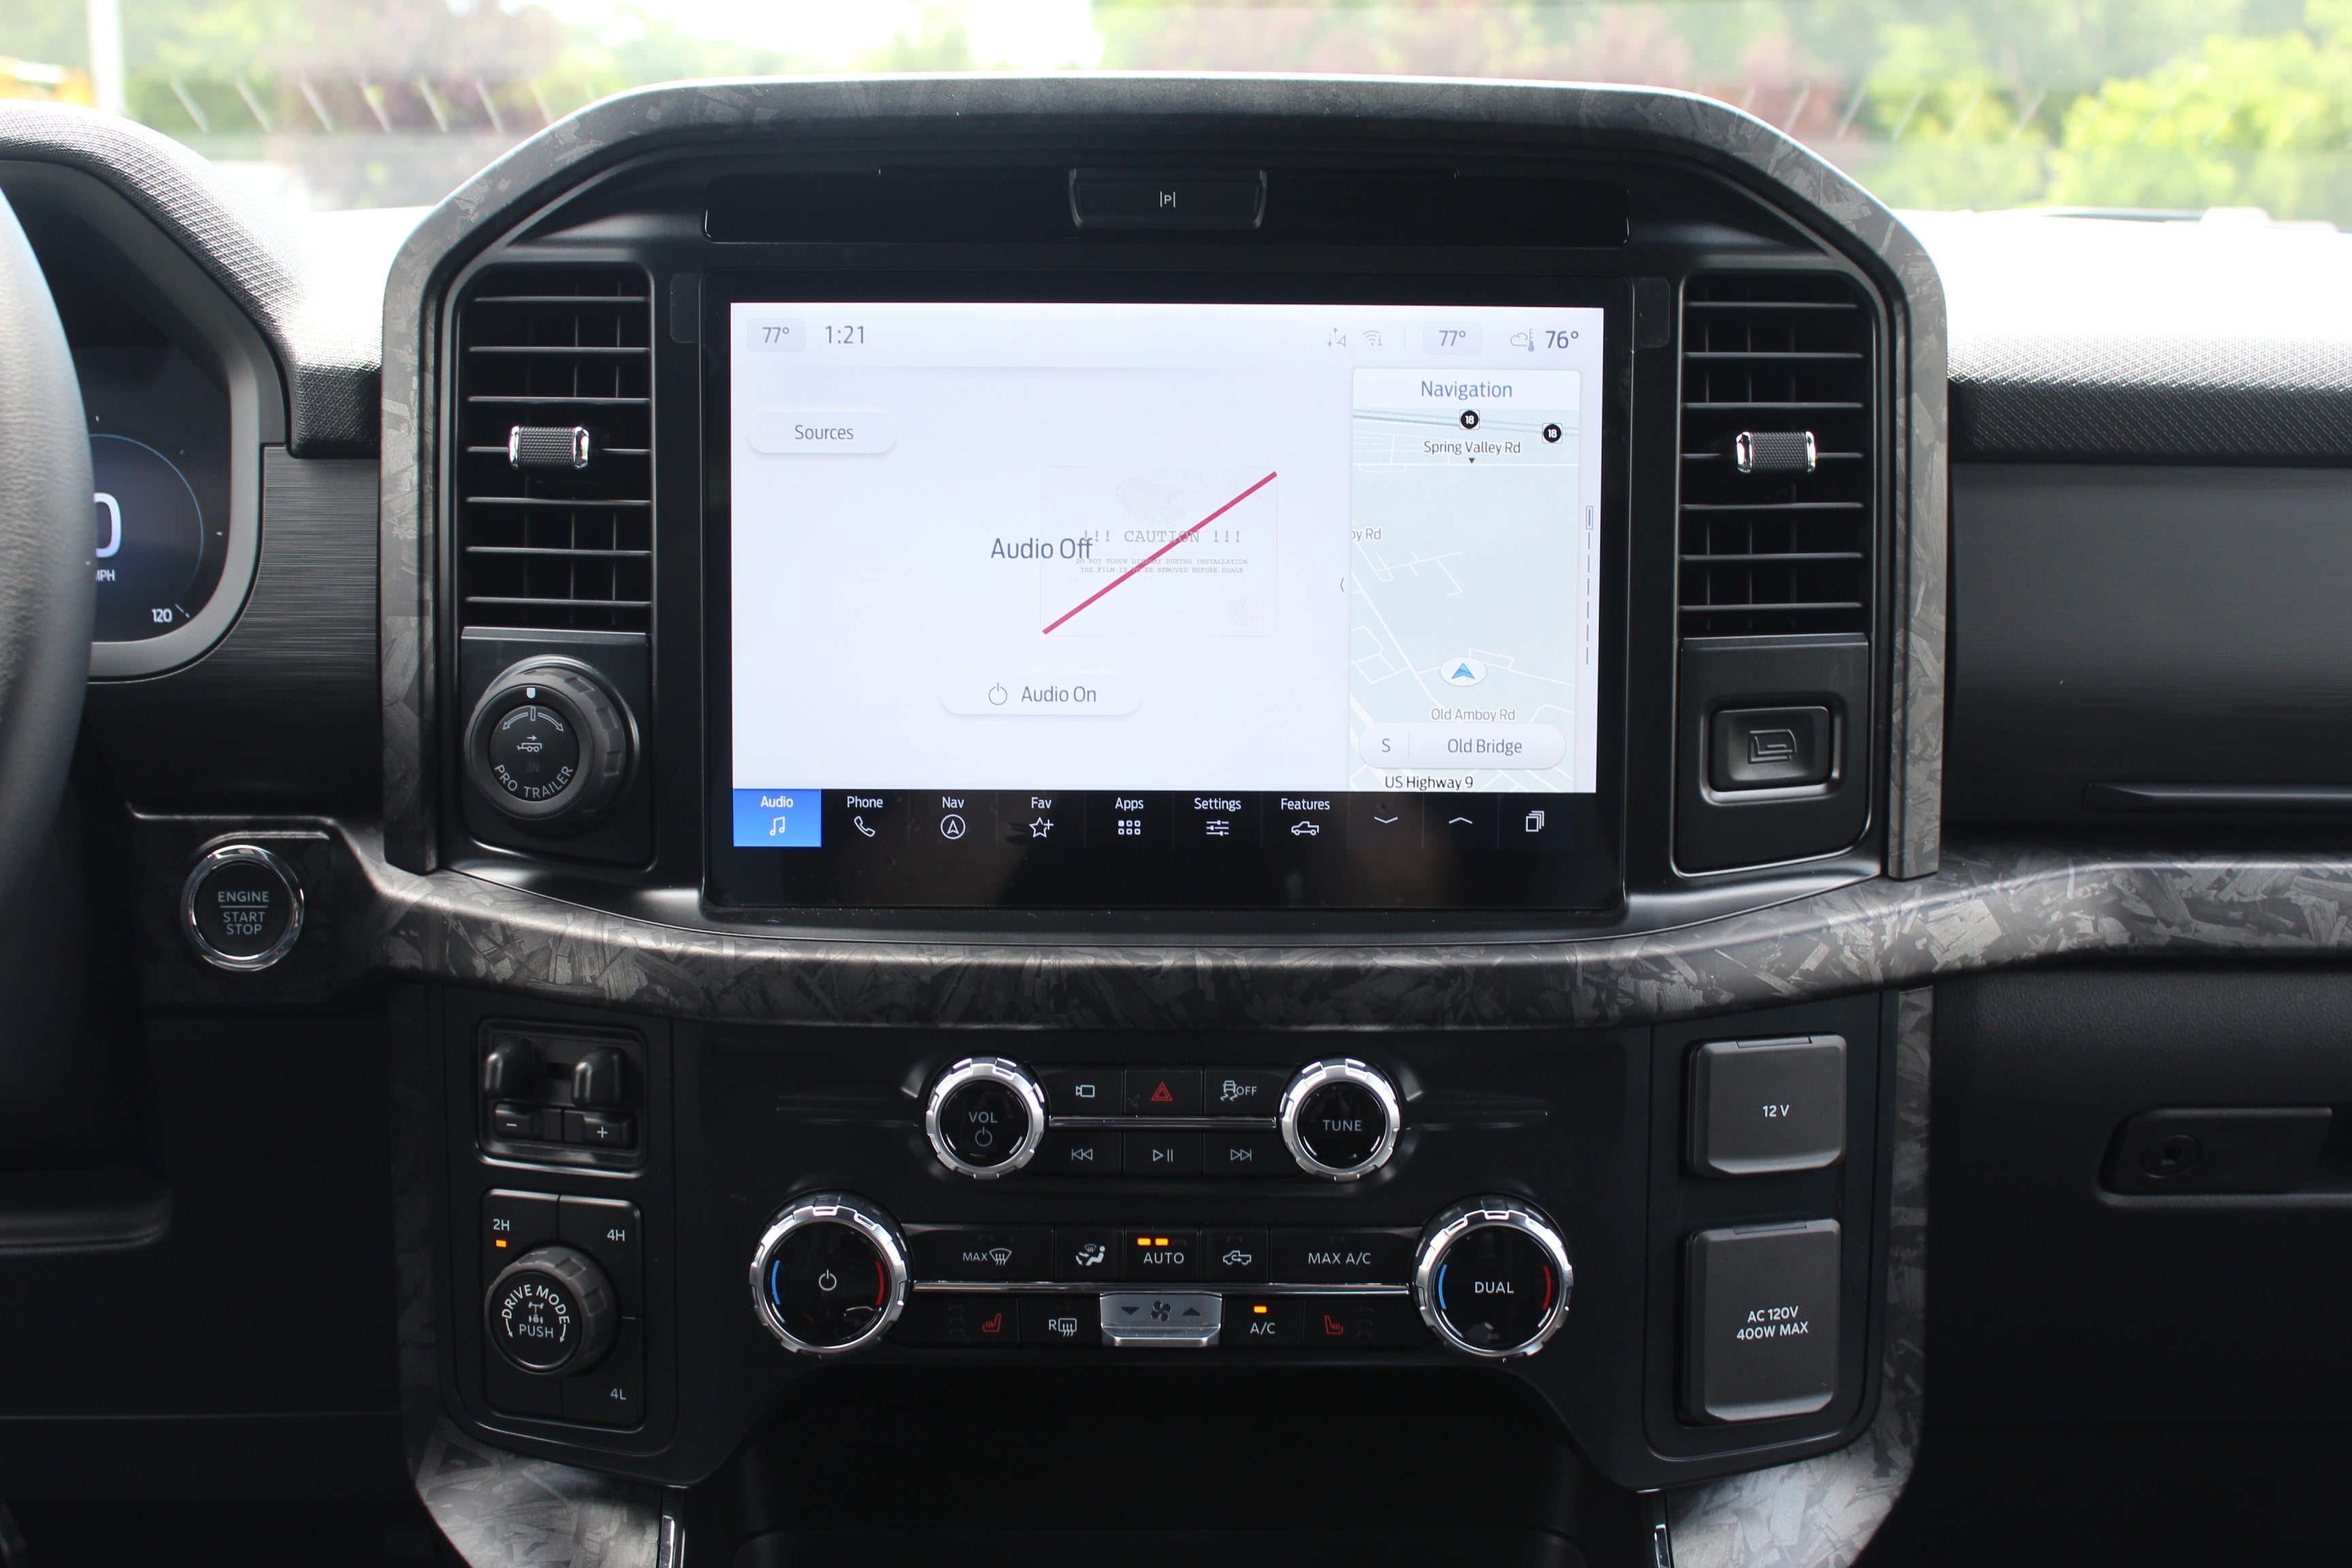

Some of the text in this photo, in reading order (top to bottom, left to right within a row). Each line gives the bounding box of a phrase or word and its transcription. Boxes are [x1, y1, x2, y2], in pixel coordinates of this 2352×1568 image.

[762, 327, 790, 344] 77°
[824, 325, 866, 344] 1:21
[1438, 329, 1467, 347] 77°
[1544, 330, 1580, 349] 76°
[1421, 380, 1513, 400] Navigation
[1465, 414, 1475, 425] 18
[794, 424, 855, 441] Sources
[1547, 428, 1558, 438] 18
[1423, 441, 1521, 455] Spring Valley Rd
[1124, 530, 1200, 542] CAUTION
[1365, 527, 1382, 540] Rd
[990, 537, 1093, 559] Audio Off
[151, 608, 173, 623] 120
[1021, 685, 1097, 703] Audio On
[1431, 708, 1516, 723] Old Amboy Rd
[1381, 738, 1391, 753] S
[1447, 738, 1523, 756] Old Bridge
[494, 764, 574, 799] PRO TRAILER
[1384, 776, 1474, 791] US Highway 9
[760, 796, 794, 808] Audio
[846, 796, 883, 808] Phone
[942, 796, 965, 808] Nav
[1030, 797, 1052, 809] Fav
[1115, 797, 1145, 811] Apps
[1194, 797, 1242, 812] Settings
[1280, 798, 1330, 811] Features
[218, 891, 270, 902] ENGINE
[223, 911, 265, 922] START
[227, 924, 262, 935] STOP
[1236, 1085, 1258, 1096] OFF
[968, 1111, 998, 1123] VOL
[1762, 1104, 1790, 1117] 12 V
[1322, 1120, 1362, 1131] TUNE
[493, 1218, 510, 1231] 2H
[606, 1228, 625, 1242] 4H
[963, 1251, 988, 1262] MAX
[1143, 1252, 1184, 1265] AUTO
[1308, 1252, 1371, 1266] MAX A/C
[1475, 1281, 1514, 1294] DUAL
[501, 1284, 570, 1325] DRIVE MODE
[1747, 1305, 1799, 1324] AC 120V
[519, 1324, 554, 1339] PUSH
[1048, 1319, 1056, 1331] R
[1250, 1322, 1275, 1337] A/C
[1736, 1321, 1809, 1341] 400W MAX
[610, 1388, 627, 1401] 4L
